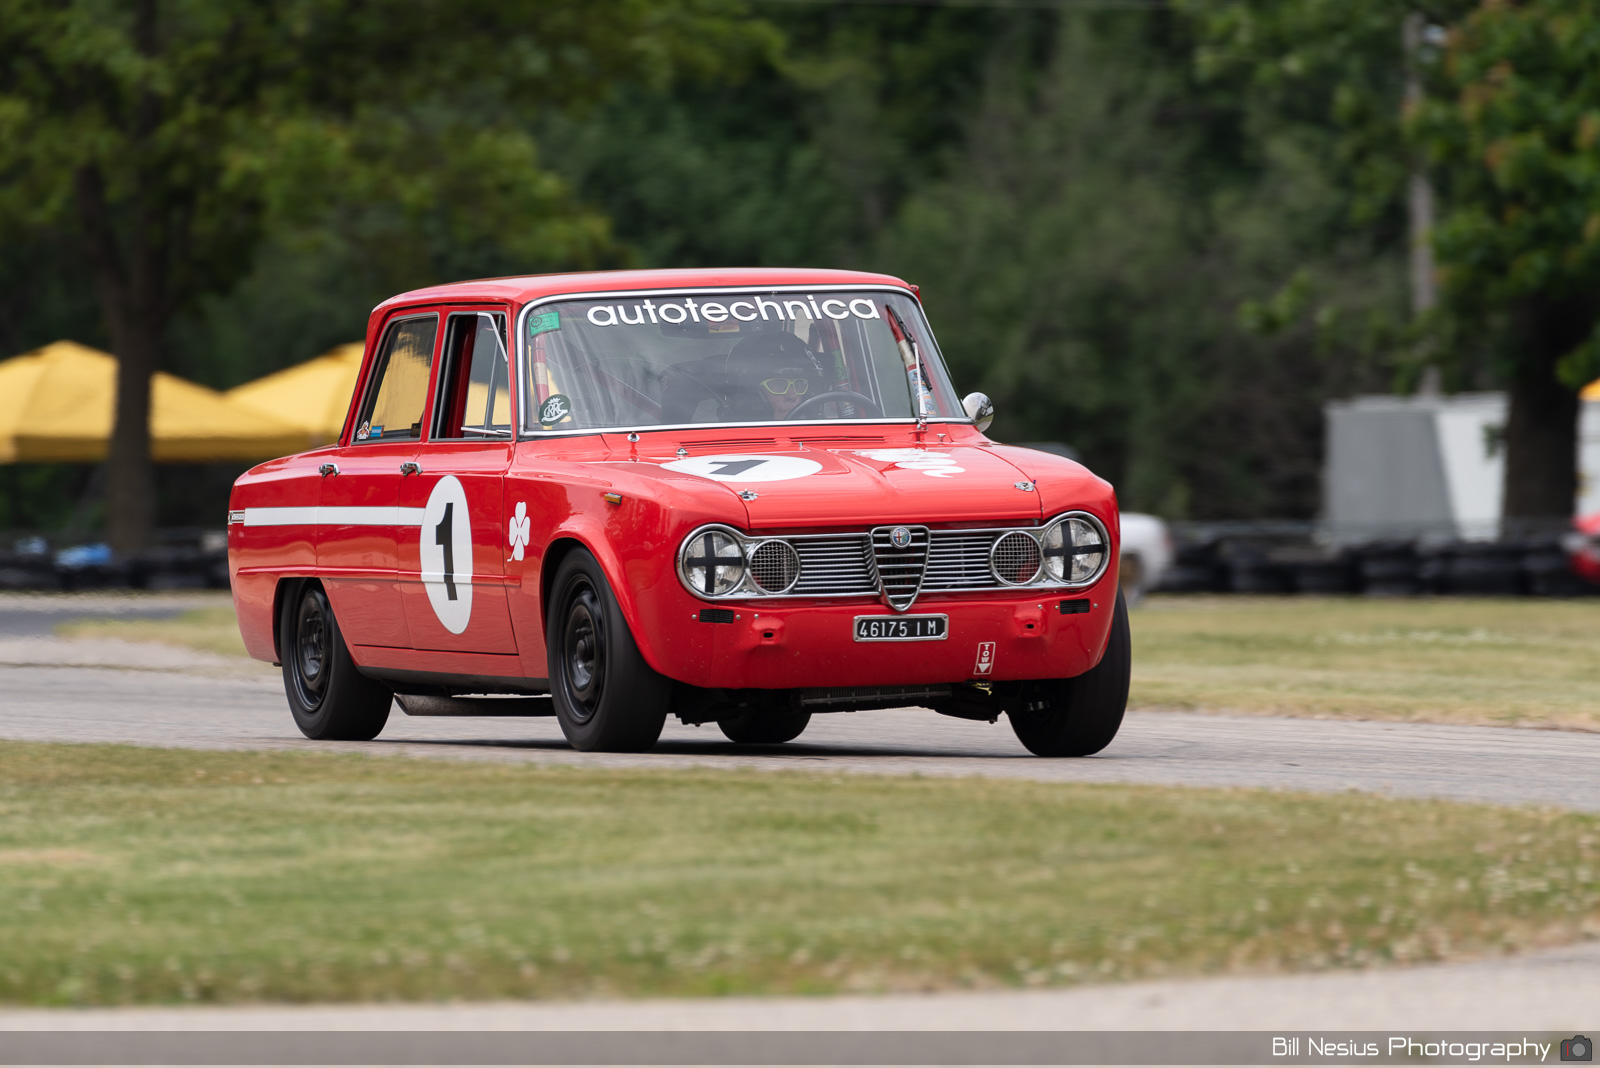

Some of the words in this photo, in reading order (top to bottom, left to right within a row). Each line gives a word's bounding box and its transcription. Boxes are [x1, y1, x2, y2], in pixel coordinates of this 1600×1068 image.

[587, 295, 880, 327] autotechnica
[709, 459, 769, 476] 1
[435, 502, 458, 601] 1
[859, 621, 908, 637] 46175
[981, 644, 990, 663] TOW
